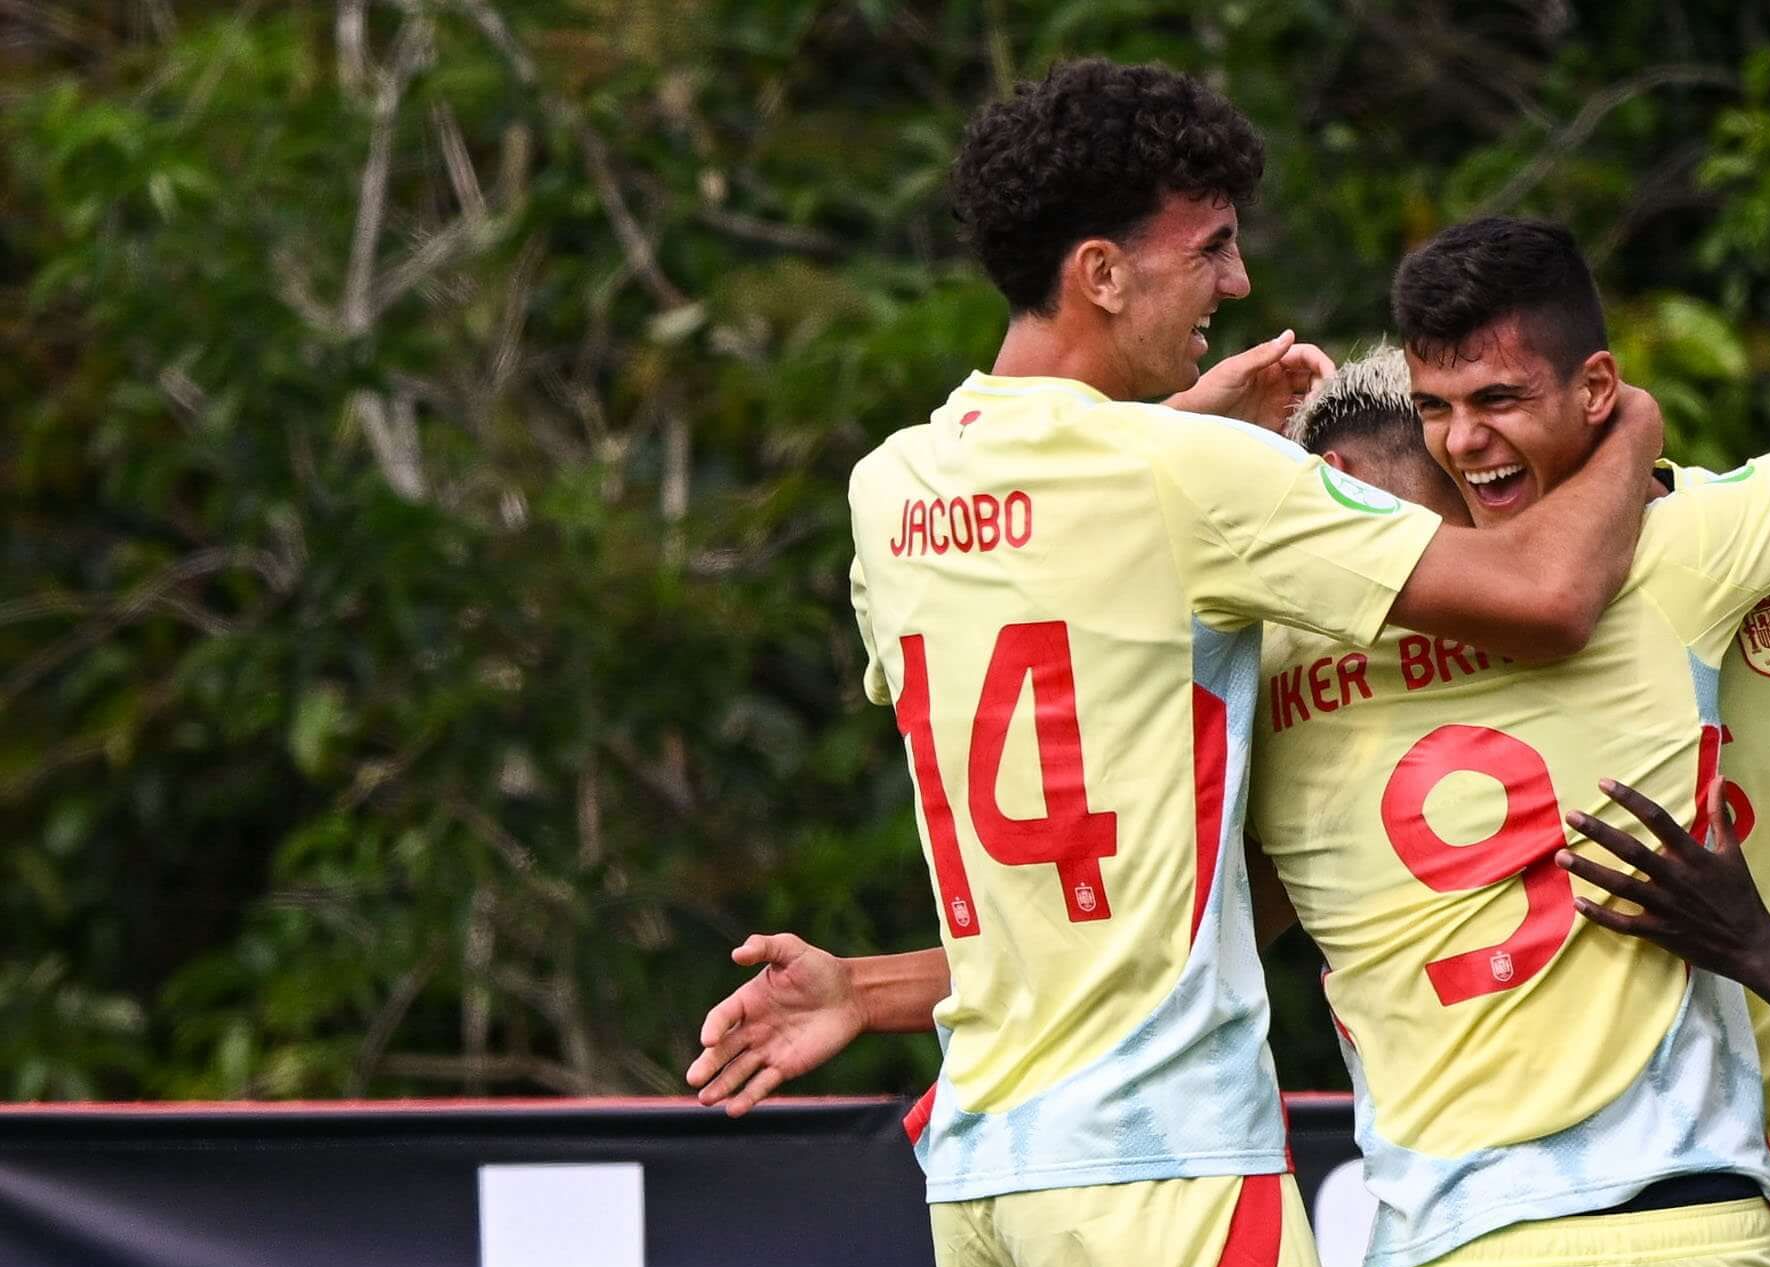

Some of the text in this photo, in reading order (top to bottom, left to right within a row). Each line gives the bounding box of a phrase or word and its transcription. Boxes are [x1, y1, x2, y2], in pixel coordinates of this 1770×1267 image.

[890, 490, 1032, 557] JACOBO
[895, 619, 1118, 939] 14
[1269, 634, 1514, 733] IKER BR
[1380, 724, 1577, 1007] 9
